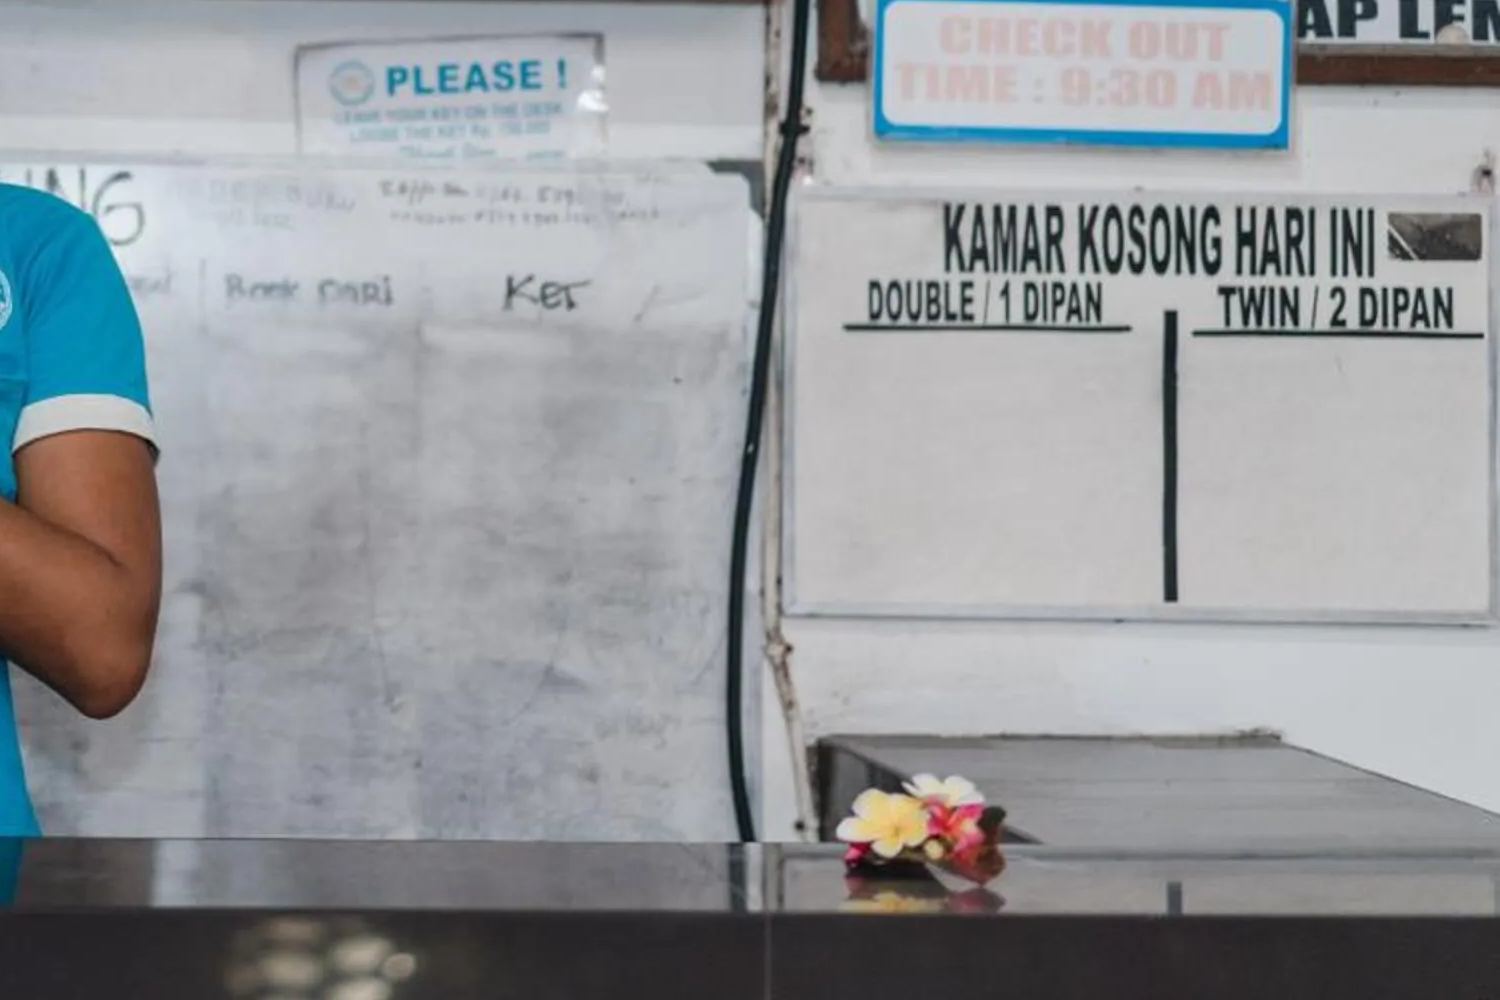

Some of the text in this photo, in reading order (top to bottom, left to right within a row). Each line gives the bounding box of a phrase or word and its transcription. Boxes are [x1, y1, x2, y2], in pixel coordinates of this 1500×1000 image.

[937, 16, 1233, 64] CHECK OUT
[385, 60, 543, 97] PLEASE
[893, 63, 1021, 106] TIME
[1191, 70, 1273, 113] AM
[944, 203, 1376, 279] KAMAR KOSONG HARI INI
[868, 280, 975, 322] DOUBLE
[1022, 281, 1103, 323] DIPAN
[1217, 285, 1301, 328] TWIN
[1330, 286, 1348, 329] 2
[1355, 287, 1454, 330] DIPAN
